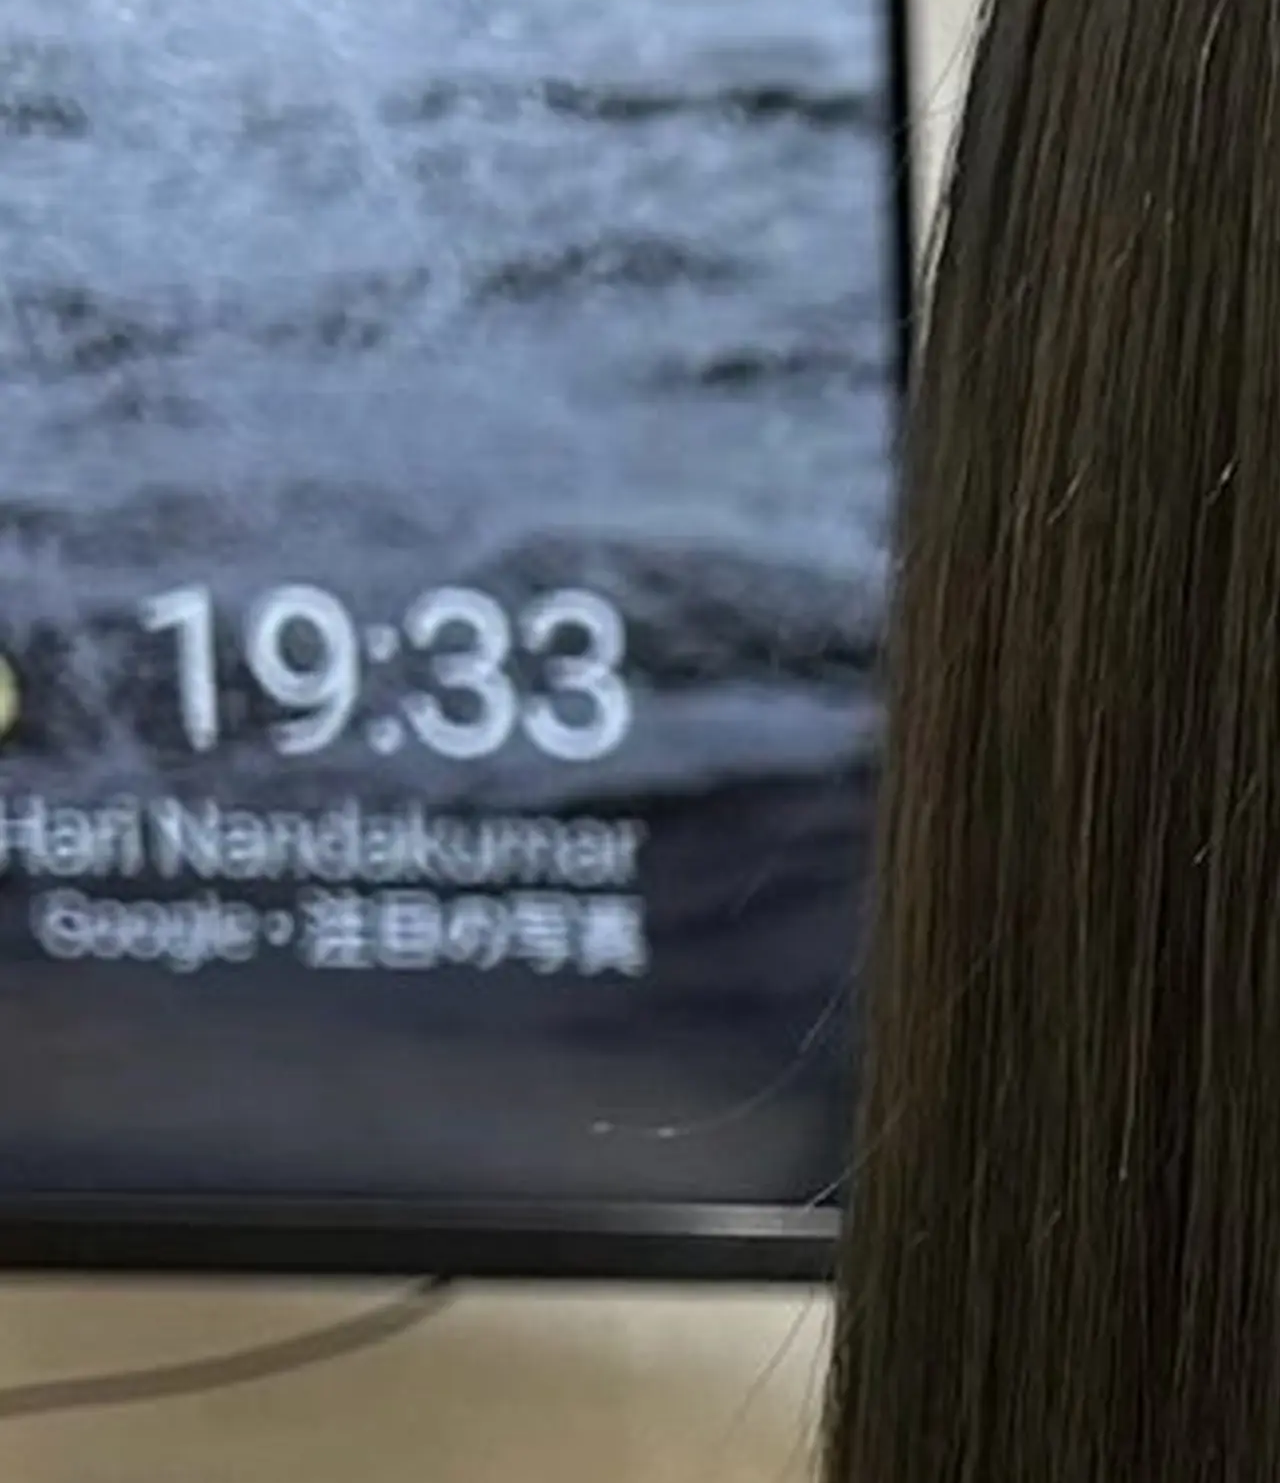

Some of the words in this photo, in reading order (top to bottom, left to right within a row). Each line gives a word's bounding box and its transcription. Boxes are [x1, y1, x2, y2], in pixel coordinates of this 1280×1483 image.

[141, 584, 634, 760] 19:33
[0, 794, 141, 878] Hari
[150, 796, 645, 885] Nandakumar
[30, 888, 259, 972] Google
